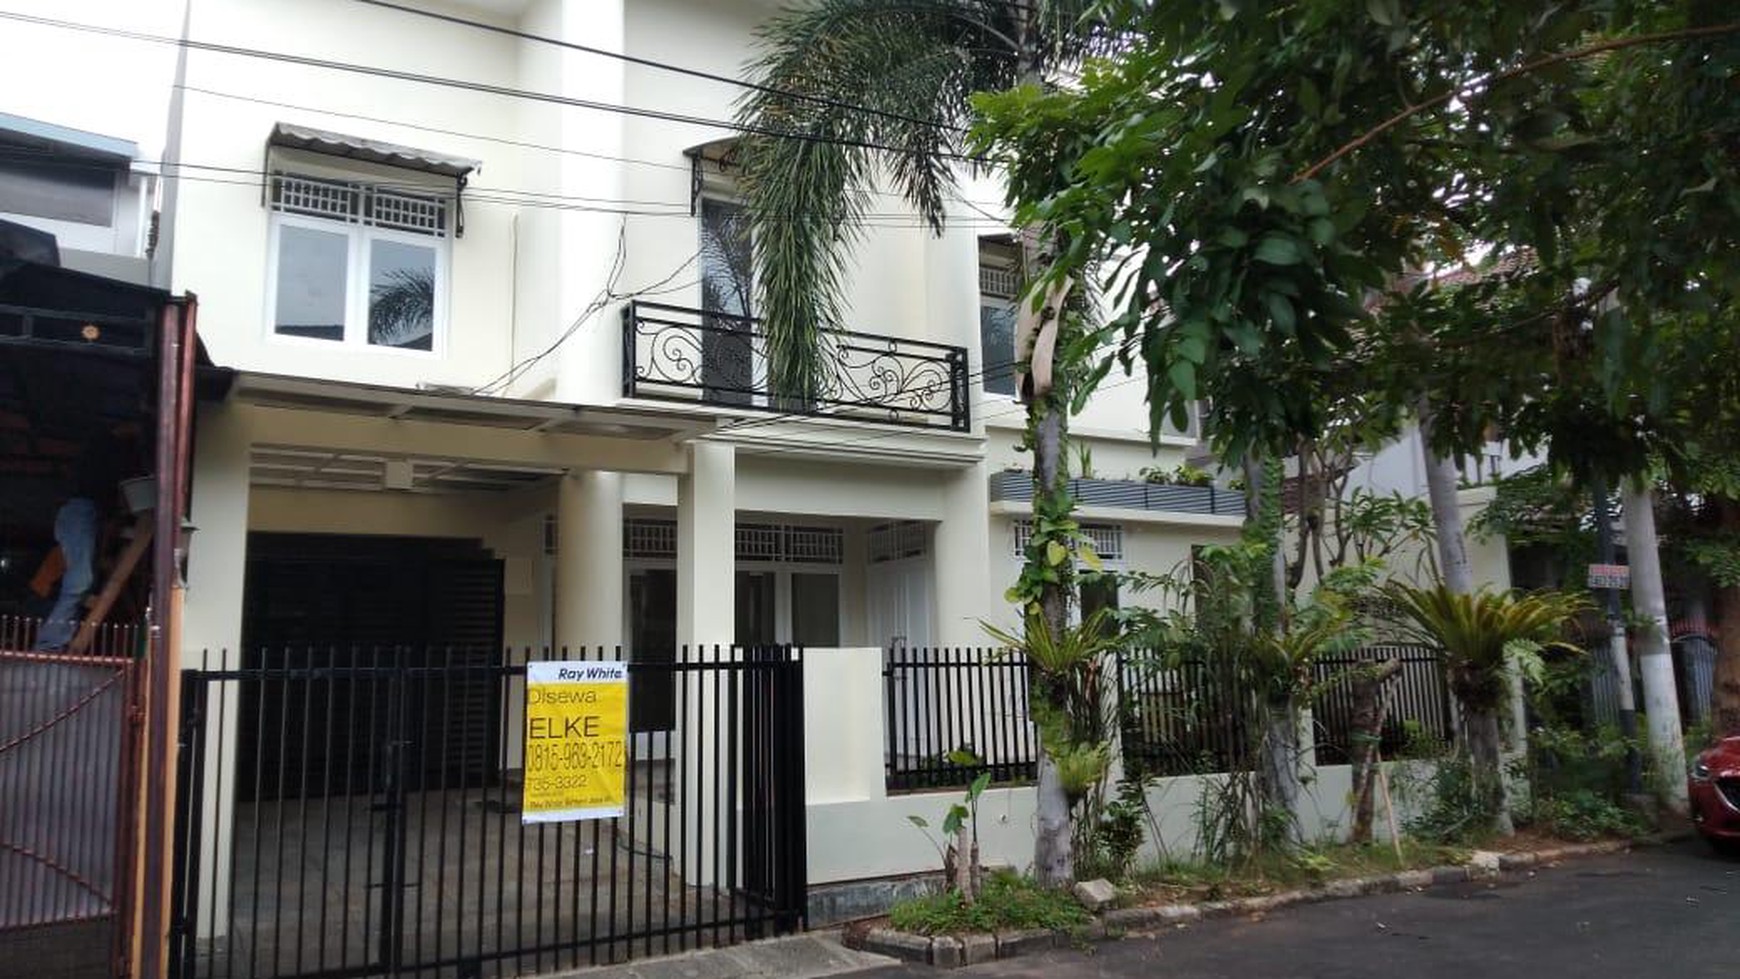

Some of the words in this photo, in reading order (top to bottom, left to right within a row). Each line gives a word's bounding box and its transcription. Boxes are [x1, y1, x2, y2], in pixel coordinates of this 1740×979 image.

[559, 668, 585, 681] Ray
[586, 668, 623, 679] White
[530, 716, 600, 738] ELKE
